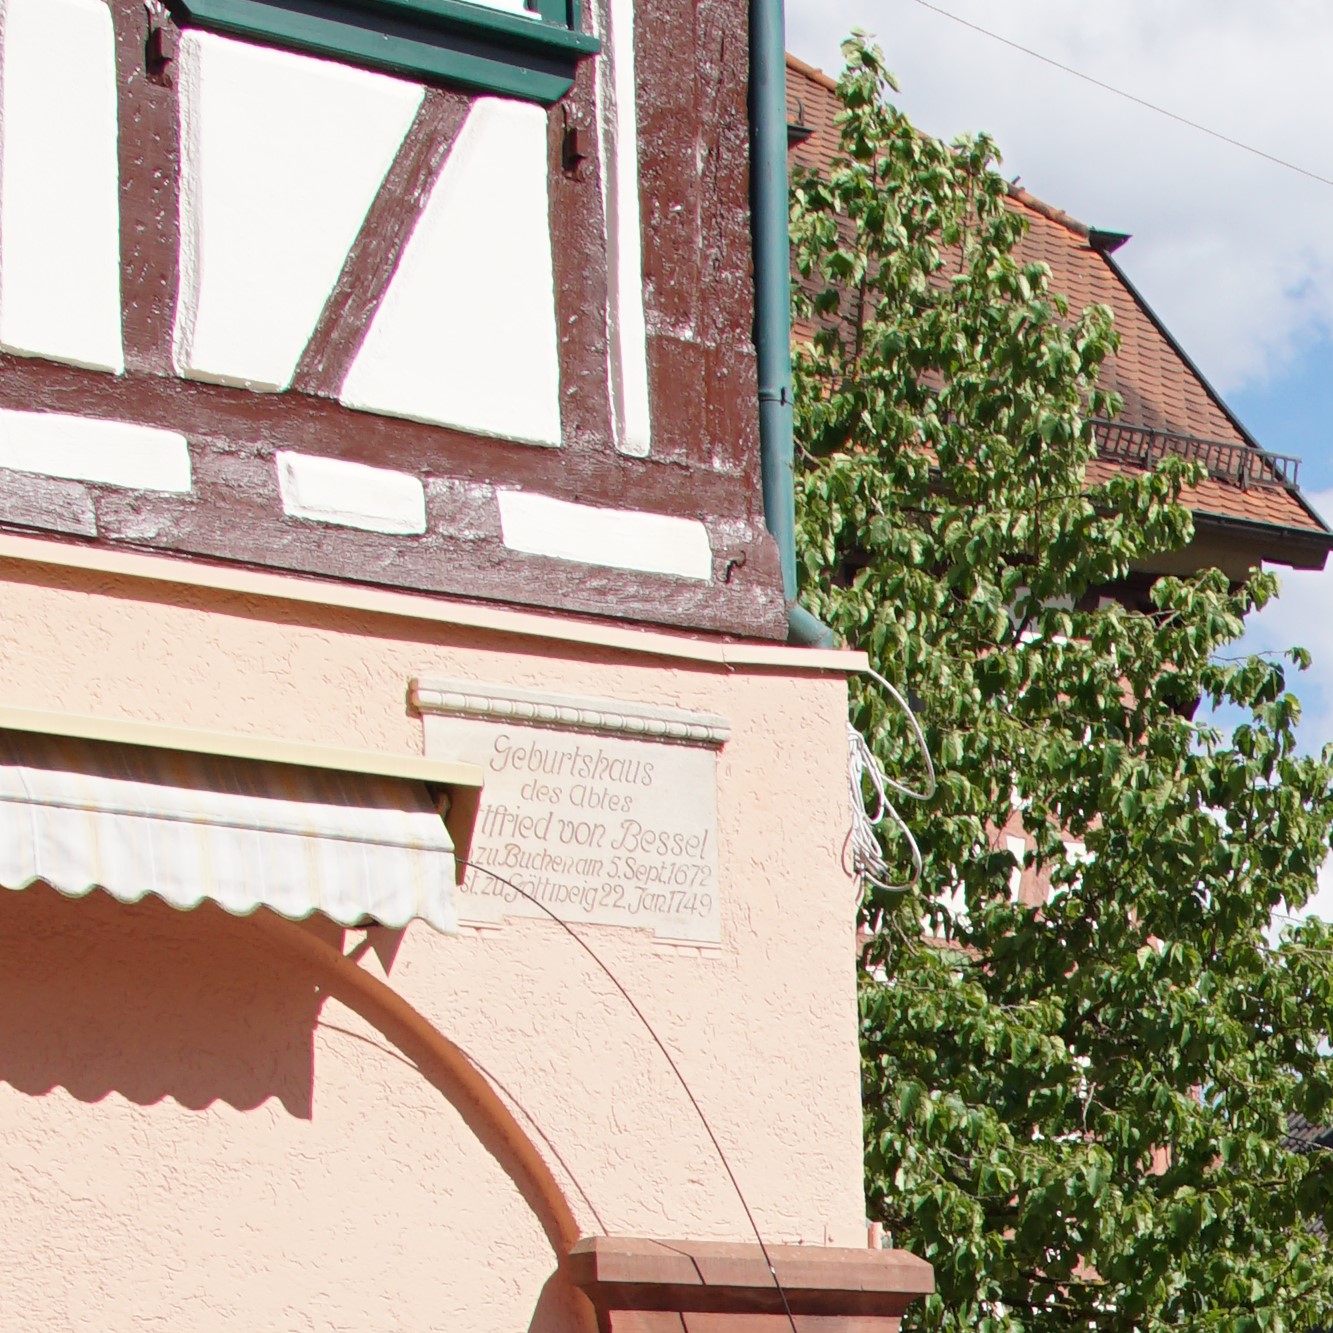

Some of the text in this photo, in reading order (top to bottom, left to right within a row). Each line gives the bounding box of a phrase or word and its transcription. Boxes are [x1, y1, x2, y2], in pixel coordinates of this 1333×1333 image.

[489, 733, 656, 787] Geburtshaus
[520, 778, 634, 814] des Abtes
[478, 803, 710, 860] tfried von Bessel
[497, 842, 574, 875] Buchen
[575, 858, 605, 878] am
[666, 862, 713, 888] 1672
[480, 874, 507, 898] zu
[666, 890, 713, 918] 1749
